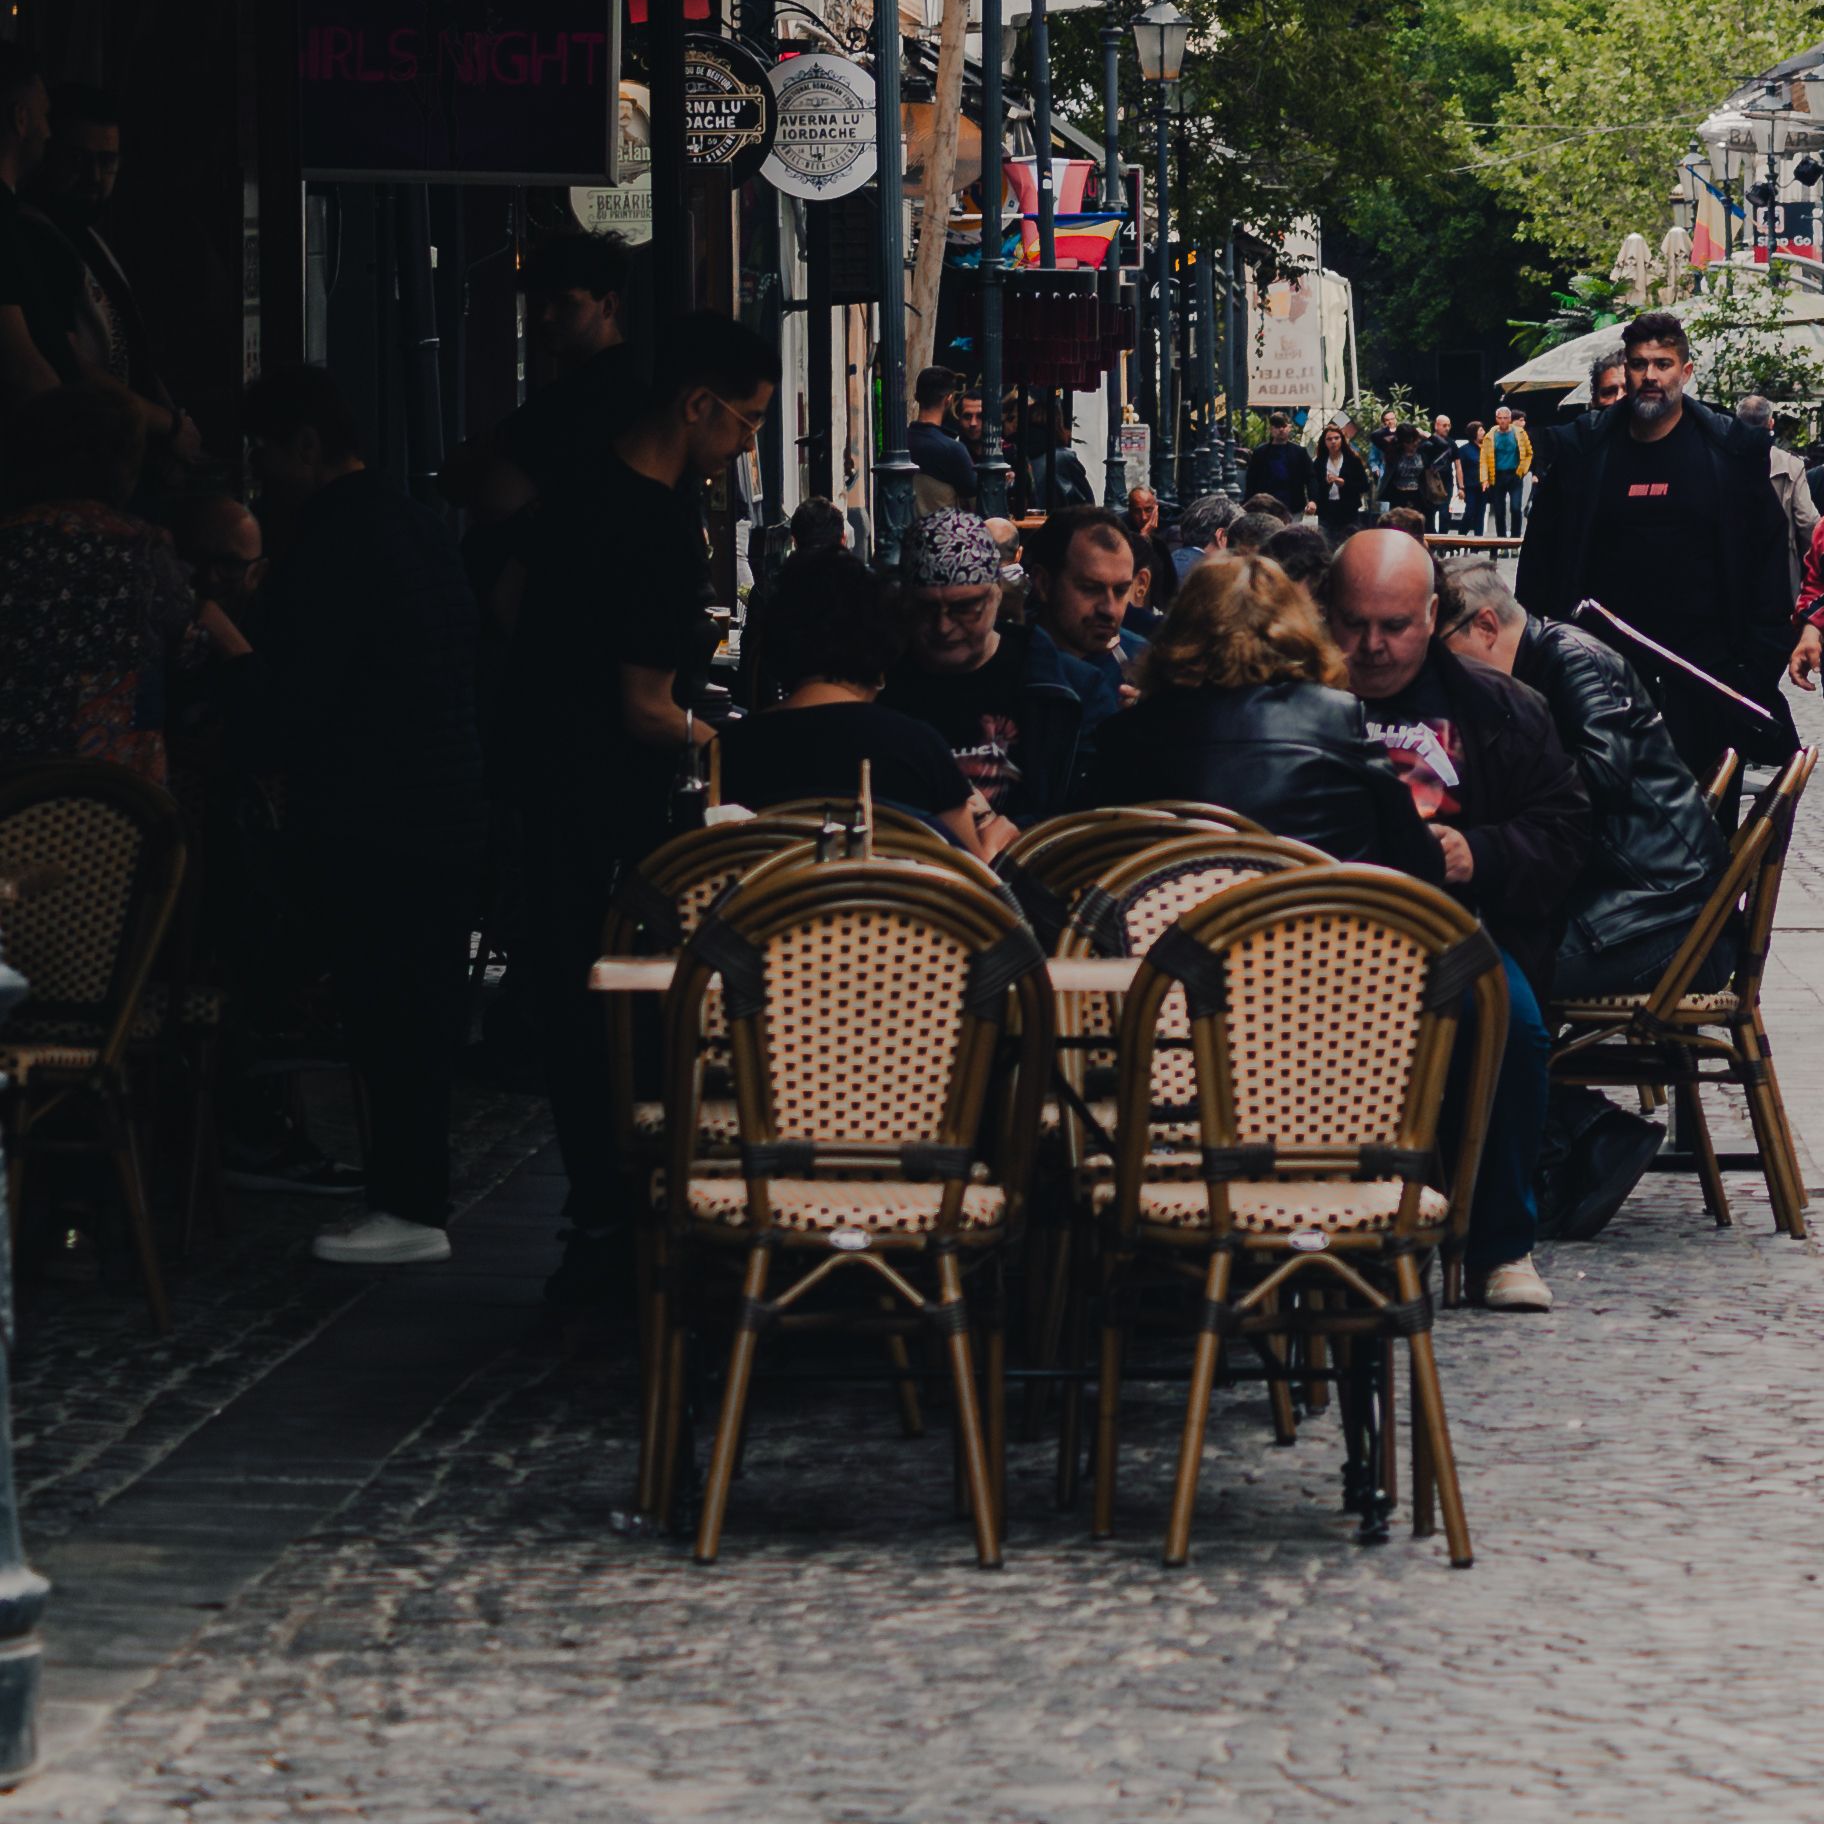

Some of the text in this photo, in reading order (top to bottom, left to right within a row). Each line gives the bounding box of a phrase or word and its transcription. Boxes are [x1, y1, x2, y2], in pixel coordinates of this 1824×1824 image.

[686, 116, 736, 128] DACHE
[780, 113, 838, 127] AVERNA
[782, 128, 857, 140] IORDACHE
